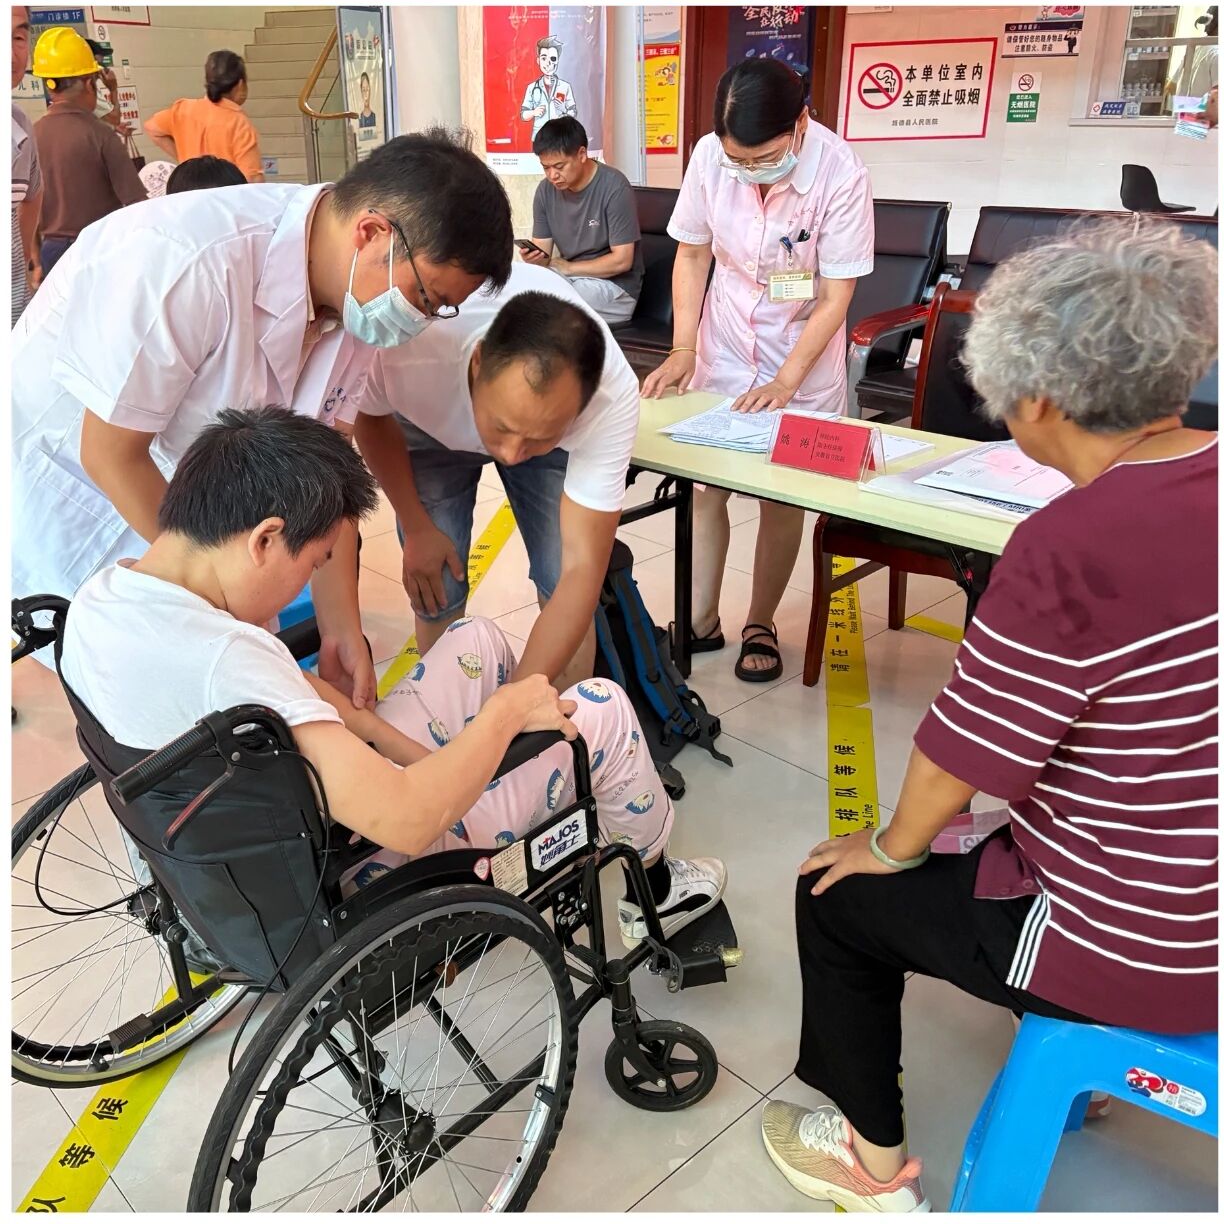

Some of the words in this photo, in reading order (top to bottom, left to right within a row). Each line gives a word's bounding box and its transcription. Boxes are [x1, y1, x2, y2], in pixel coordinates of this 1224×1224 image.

[72, 11, 81, 20] 1F
[1006, 34, 1063, 44] 请保管好您的随身物品
[904, 61, 985, 85] 本单位室内
[902, 87, 981, 109] 全面禁止吸烟
[834, 744, 859, 821] 排队等候
[862, 803, 874, 819] Line
[538, 819, 580, 856] MAJOS
